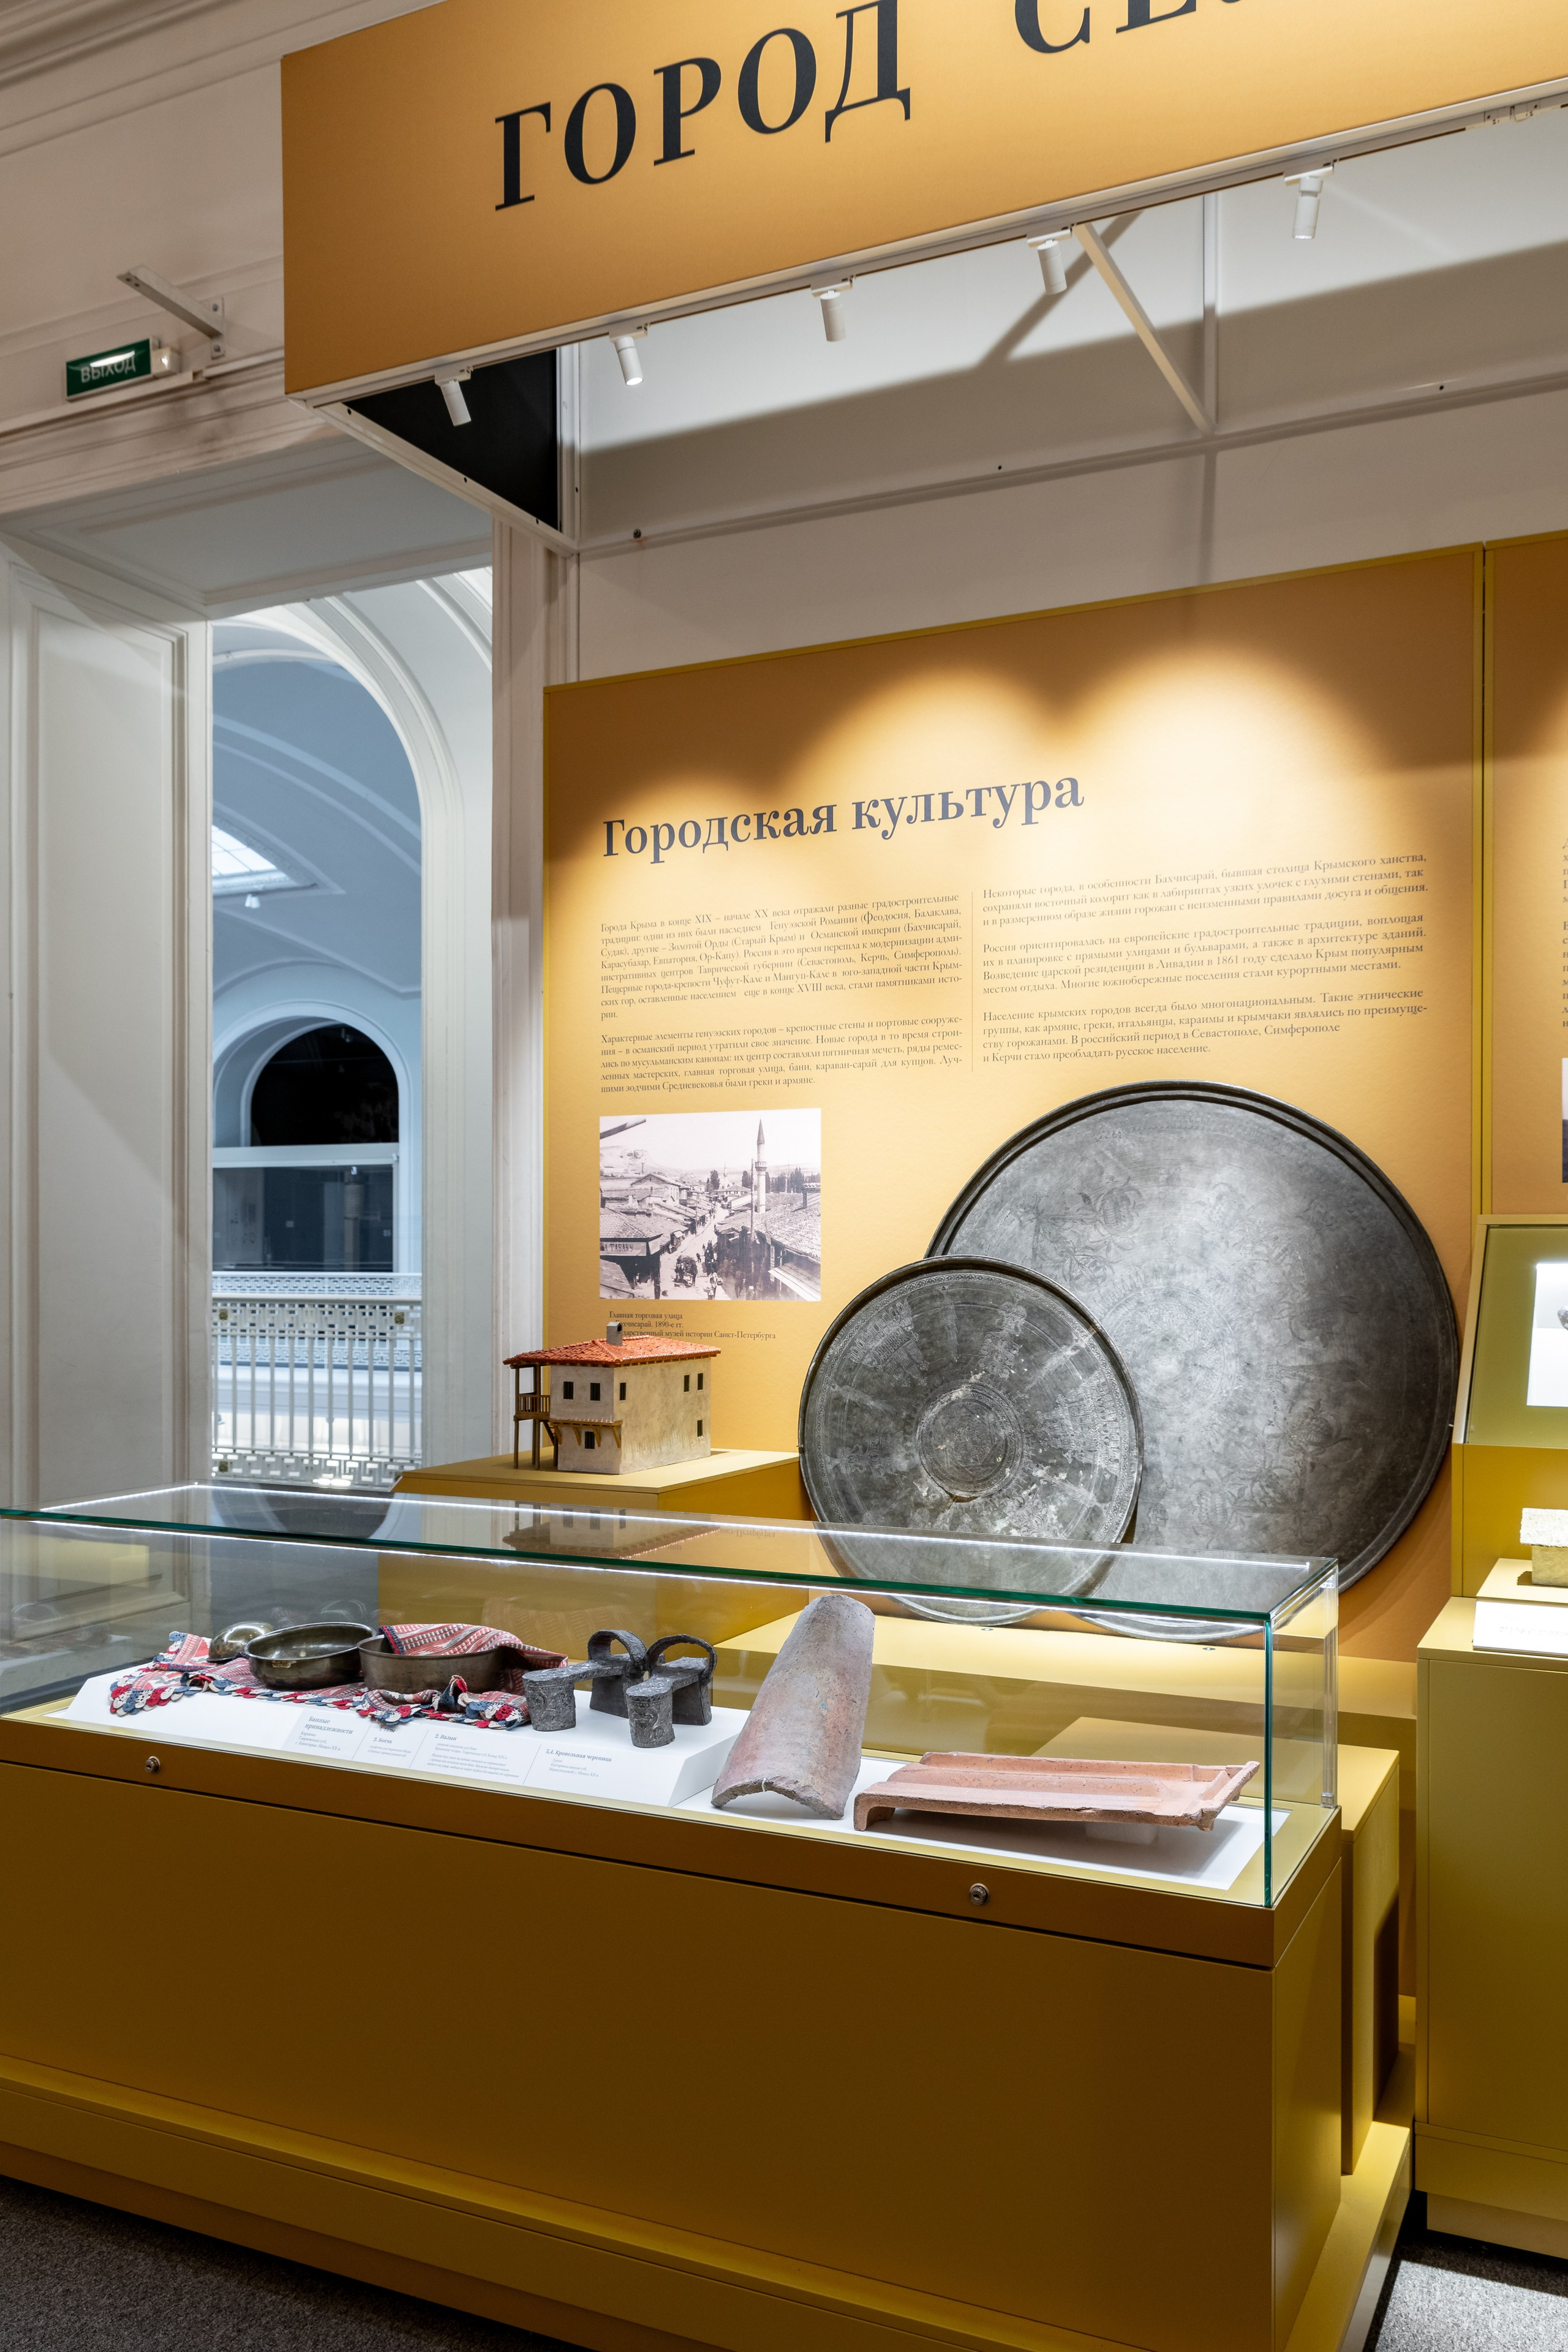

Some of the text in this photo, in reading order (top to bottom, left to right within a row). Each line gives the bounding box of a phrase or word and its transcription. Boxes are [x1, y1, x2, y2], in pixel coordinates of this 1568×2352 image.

[495, 0, 910, 211] ГОРОД
[81, 352, 135, 383] ВЫХОД
[603, 777, 1085, 864] Городская культура
[983, 888, 1036, 899] Некоторые
[1087, 878, 1151, 889] особенности
[1221, 869, 1262, 878] бывшая
[1266, 864, 1310, 875] столица
[1314, 859, 1376, 873] Крымского
[983, 943, 1016, 953] Россия
[1020, 937, 1105, 953] ориентировалась
[1124, 930, 1189, 945] европейские
[1194, 924, 1300, 940] градостроительные
[1303, 919, 1363, 933] традиции,
[1366, 915, 1424, 925] воплощая
[601, 970, 657, 983] нистративных
[660, 967, 693, 979] центров
[697, 961, 749, 975] Таврической
[753, 959, 793, 972] губернии
[861, 952, 889, 964] Керчь,
[601, 984, 643, 995] Пещерные
[644, 979, 710, 993] города-крепости
[713, 974, 763, 988] Чуфут-Кале
[773, 970, 830, 982] Мангуп-Кале
[842, 964, 902, 976] юго-западной
[933, 962, 962, 973] Крым-
[983, 970, 1039, 981] Возведение
[1041, 965, 1081, 979] царской
[1084, 963, 1145, 976] резиденции
[1156, 959, 1204, 969] Ливадии
[1217, 954, 1238, 965] 1861
[1243, 955, 1267, 965] году
[1270, 952, 1313, 963] сделало
[1316, 949, 1348, 961] Крым
[1351, 945, 1424, 958] популярным
[983, 963, 1401, 994] местом отдыха. Многие южнобережные поселения стали курортными местами.
[983, 1026, 1022, 1038] группы,
[1042, 1023, 1080, 1035] армяне,
[1084, 1021, 1115, 1032] греки,
[1117, 1018, 1176, 1028] итальянцы,
[1179, 1016, 1224, 1027] караимы
[1237, 1012, 1291, 1024] крымчаки
[1294, 1009, 1344, 1019] являлись
[1363, 1005, 1428, 1018] преимуще-
[984, 1011, 1035, 1021] Население
[1038, 1009, 1087, 1021] крымских
[1091, 1006, 1131, 1017] городов
[1134, 1005, 1167, 1014] всегда
[1170, 1001, 1197, 1011] было
[1321, 993, 1354, 1003] Такие
[1357, 991, 1423, 1001] этнические
[982, 1041, 1005, 1051] ству
[1007, 1038, 1068, 1050] горожанами.
[1080, 1032, 1140, 1047] российский
[1142, 1032, 1180, 1044] период
[1264, 1025, 1340, 1038] Симферополе
[631, 1056, 693, 1069] мусульманским
[695, 1054, 732, 1063] канонам:
[746, 1052, 772, 1062] центр
[773, 1050, 820, 1058] составляли
[823, 1047, 869, 1056] пятничная
[907, 1045, 930, 1055] ряды
[933, 1044, 962, 1054] ремес-
[633, 1069, 680, 1080] мастерских,
[718, 1066, 755, 1077] торговая
[758, 1065, 785, 1075] улица,
[789, 1061, 812, 1071] бани,
[816, 1058, 877, 1072] караван-сарай
[881, 1060, 897, 1069] для
[901, 1058, 936, 1069] купцов.
[940, 1055, 962, 1067] Луч-
[625, 1083, 660, 1093] зодчими
[662, 1080, 723, 1092] Средневековья
[725, 1078, 747, 1087] были
[748, 1079, 773, 1089] греки
[782, 1078, 815, 1088] армяне.
[616, 1320, 653, 1329] хчисарай.
[714, 1330, 775, 1340] Санкт-Петербурга
[304, 1724, 353, 1735] принадлежности
